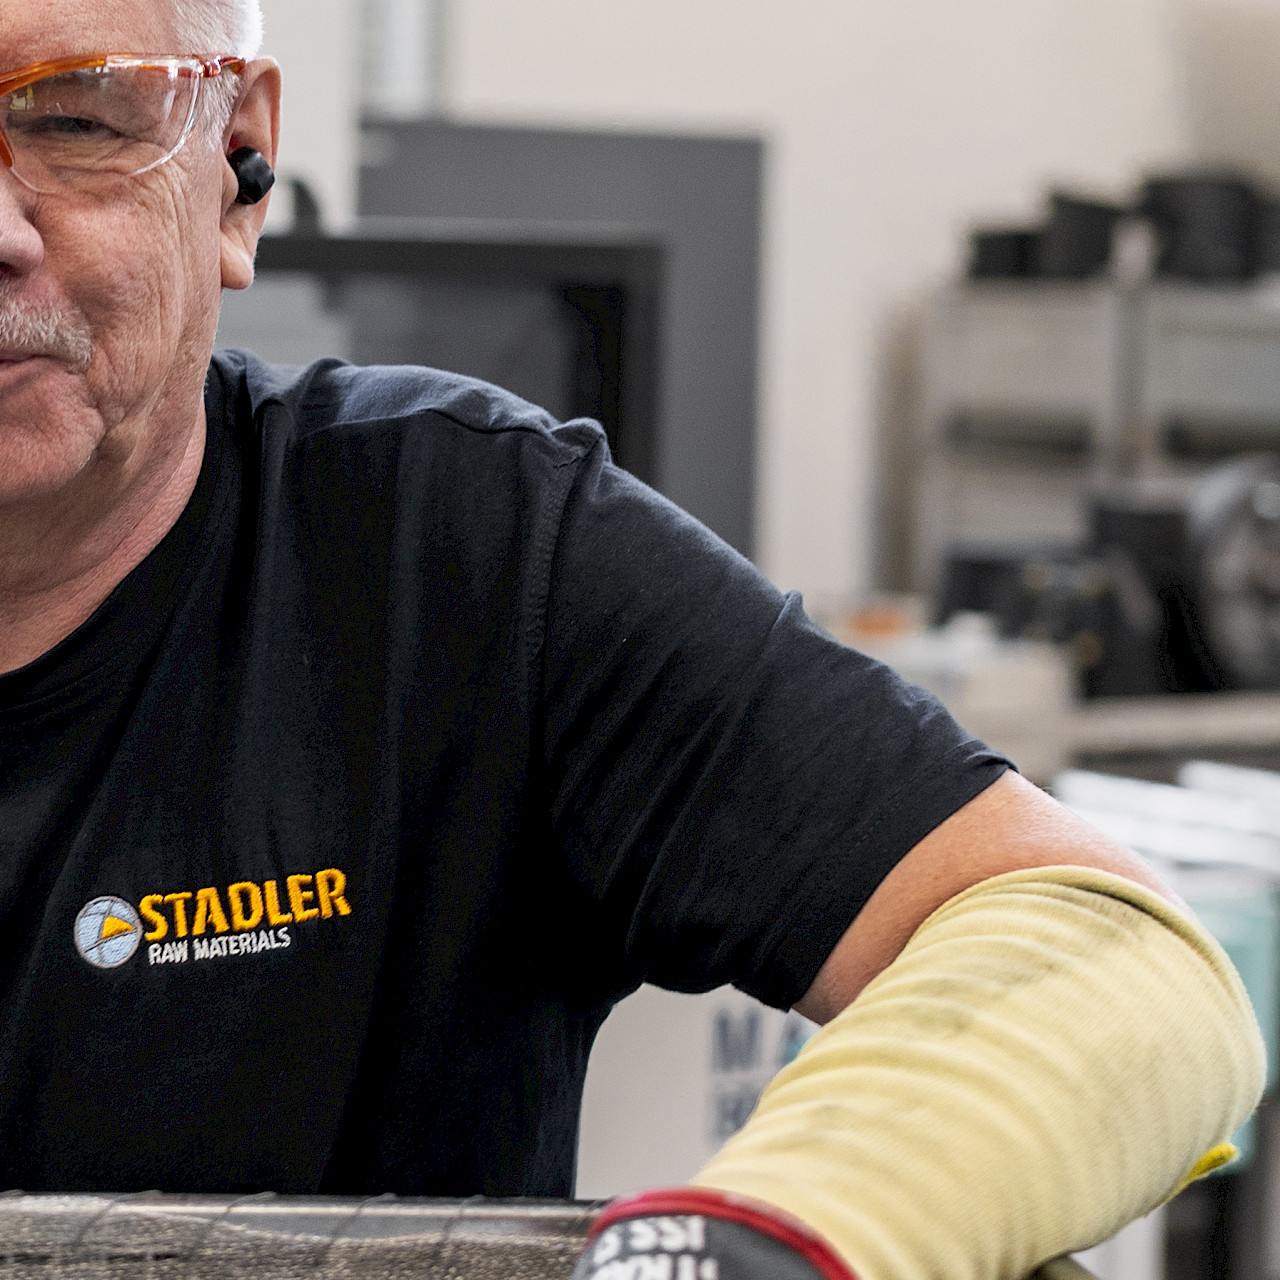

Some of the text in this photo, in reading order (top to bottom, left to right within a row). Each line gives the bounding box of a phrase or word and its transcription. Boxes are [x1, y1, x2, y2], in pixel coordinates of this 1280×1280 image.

[138, 868, 352, 941] STADLER
[148, 926, 291, 966] RAW MATERIALS
